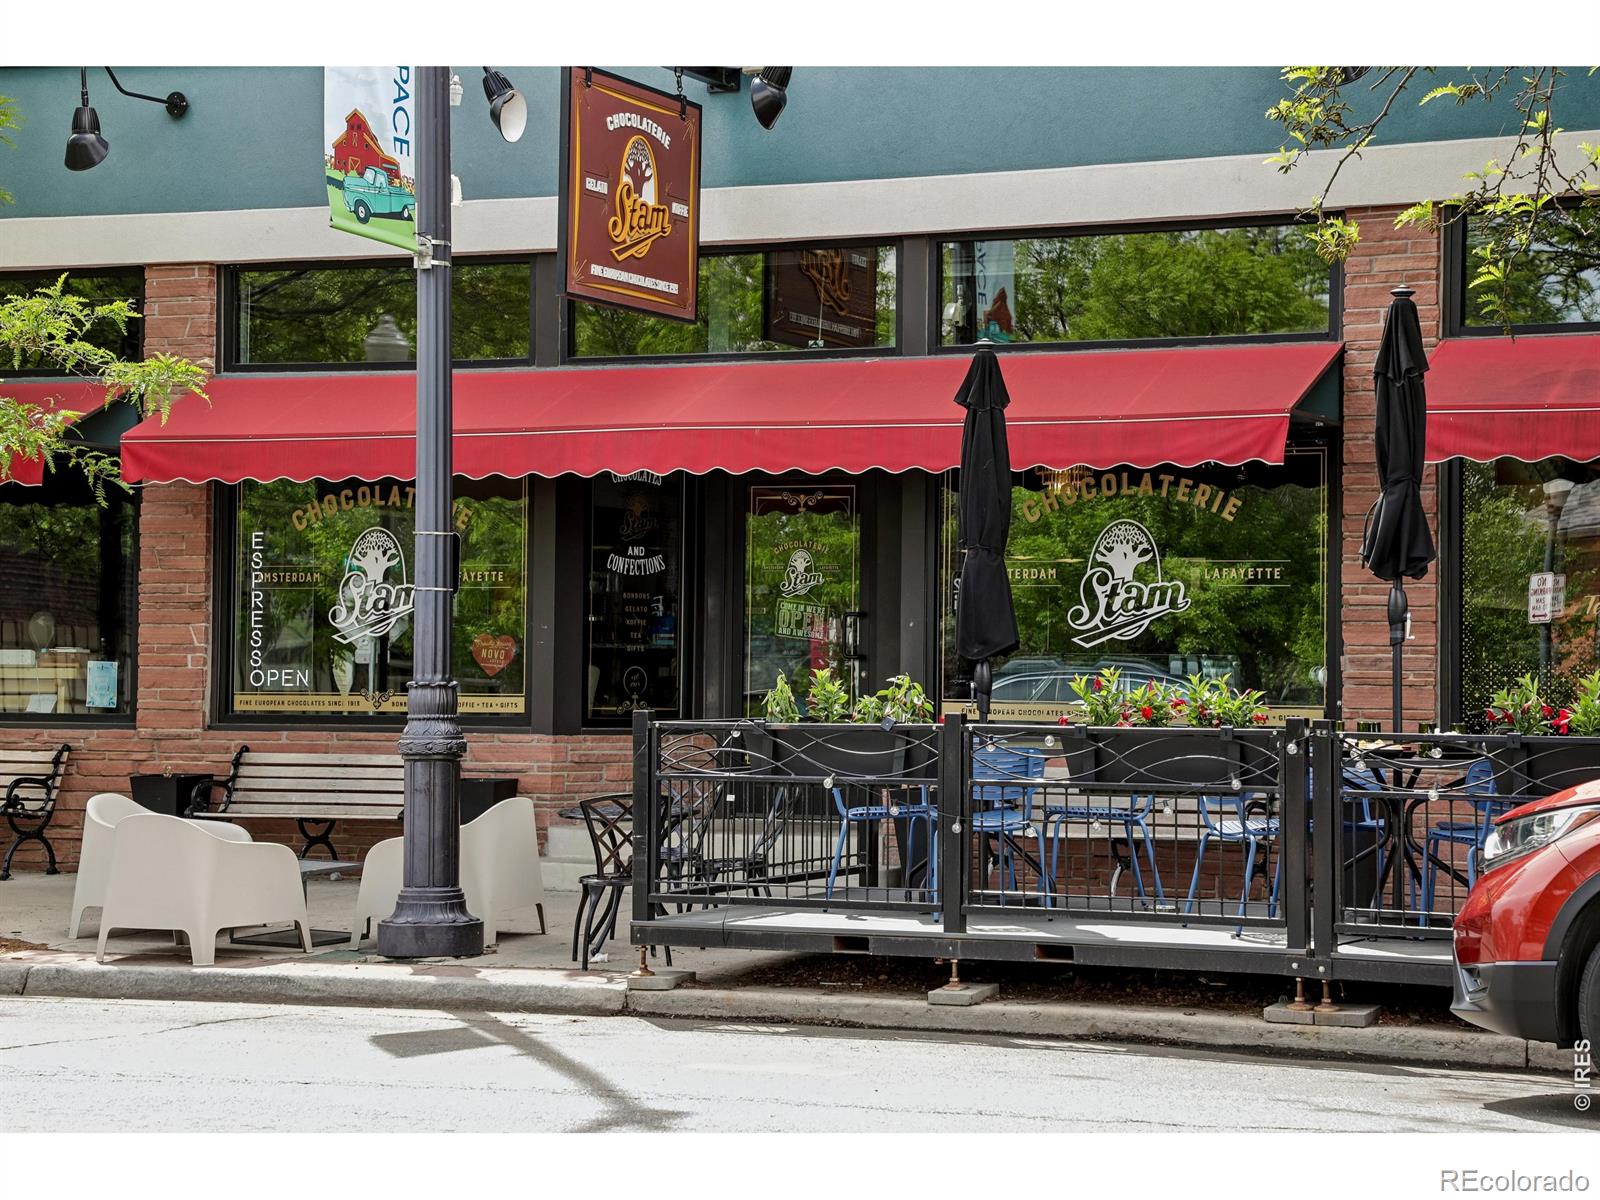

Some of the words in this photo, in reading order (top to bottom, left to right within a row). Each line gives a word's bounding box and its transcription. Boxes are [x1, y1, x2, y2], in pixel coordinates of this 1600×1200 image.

[606, 112, 672, 150] CHOCOLATERIE
[608, 181, 672, 244] Stam
[1022, 472, 1243, 524] CHOCOLATERIE
[627, 546, 645, 556] AND
[774, 541, 830, 554] CHOCOLATERIE
[607, 553, 666, 576] CONFECTIONS
[257, 572, 321, 583] AMSTERDAM
[459, 572, 505, 582] AYETTE
[780, 567, 825, 591] Stam
[1006, 568, 1057, 580] TERDAM
[1205, 568, 1281, 580] LAFAYETTE
[1067, 567, 1192, 630] Stam
[780, 602, 797, 611] COME
[798, 603, 805, 611] IN
[778, 609, 825, 632] OPEN
[778, 627, 791, 635] AND
[792, 628, 824, 639] AWESOME
[481, 648, 505, 660] NOVO
[250, 669, 309, 687] OPEN
[1017, 709, 1064, 717] CHOCOLATES
